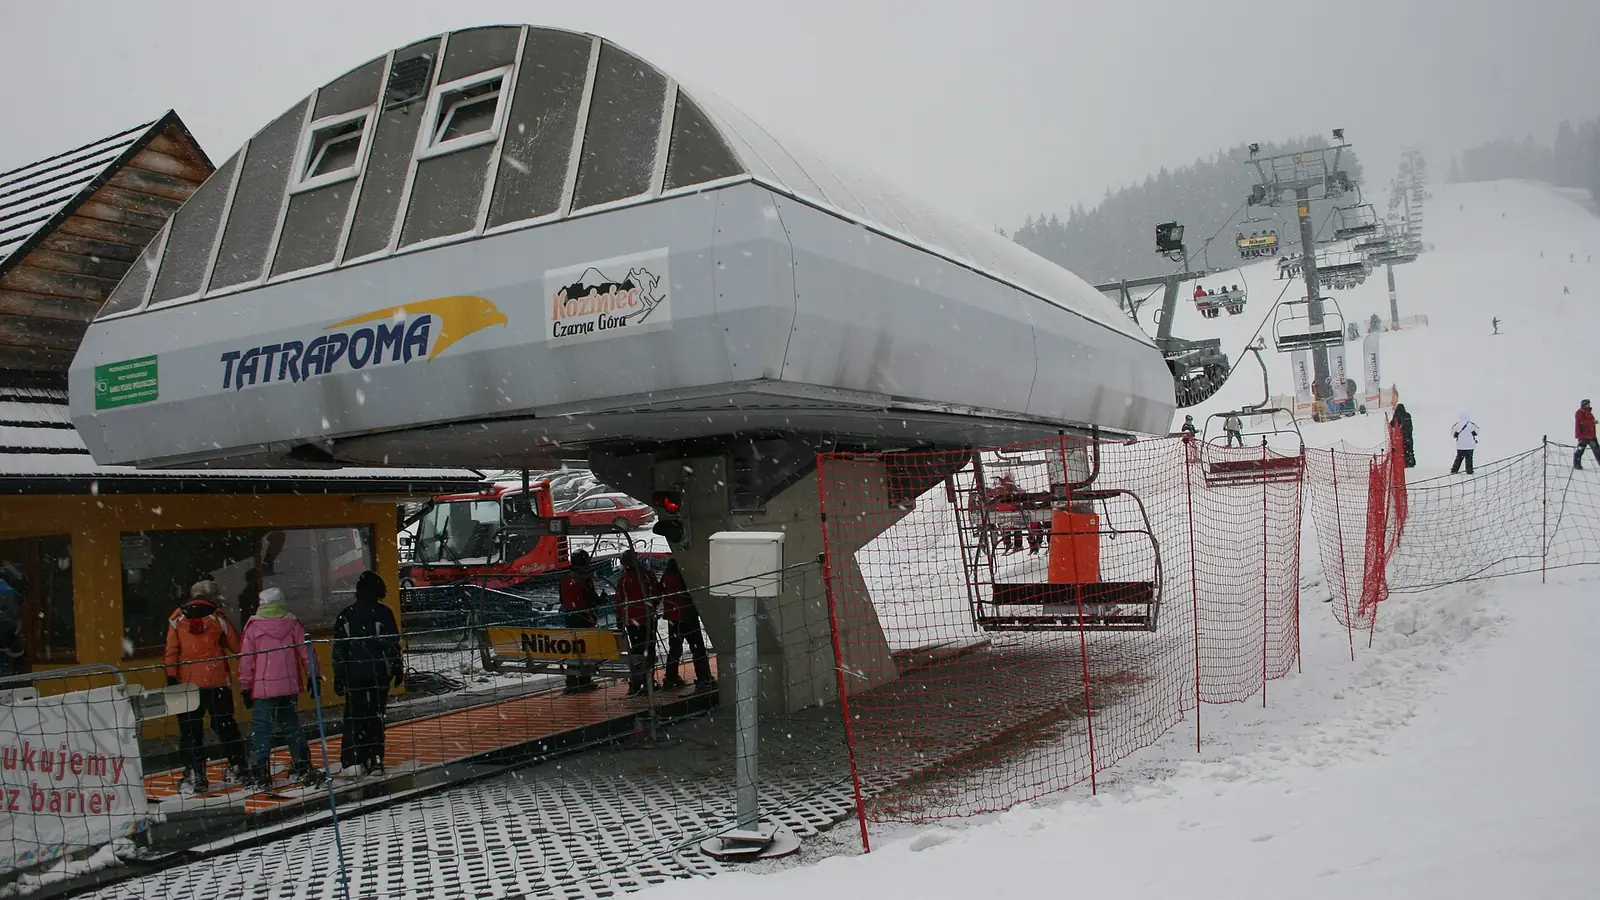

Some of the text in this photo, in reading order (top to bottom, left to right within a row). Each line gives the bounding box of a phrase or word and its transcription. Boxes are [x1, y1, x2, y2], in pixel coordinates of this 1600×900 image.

[552, 285, 639, 321] Koziniec
[553, 313, 627, 338] Czarna Góra
[220, 314, 431, 391] TATRAPOMA
[521, 633, 586, 655] Nikon
[32, 783, 116, 814] barier
